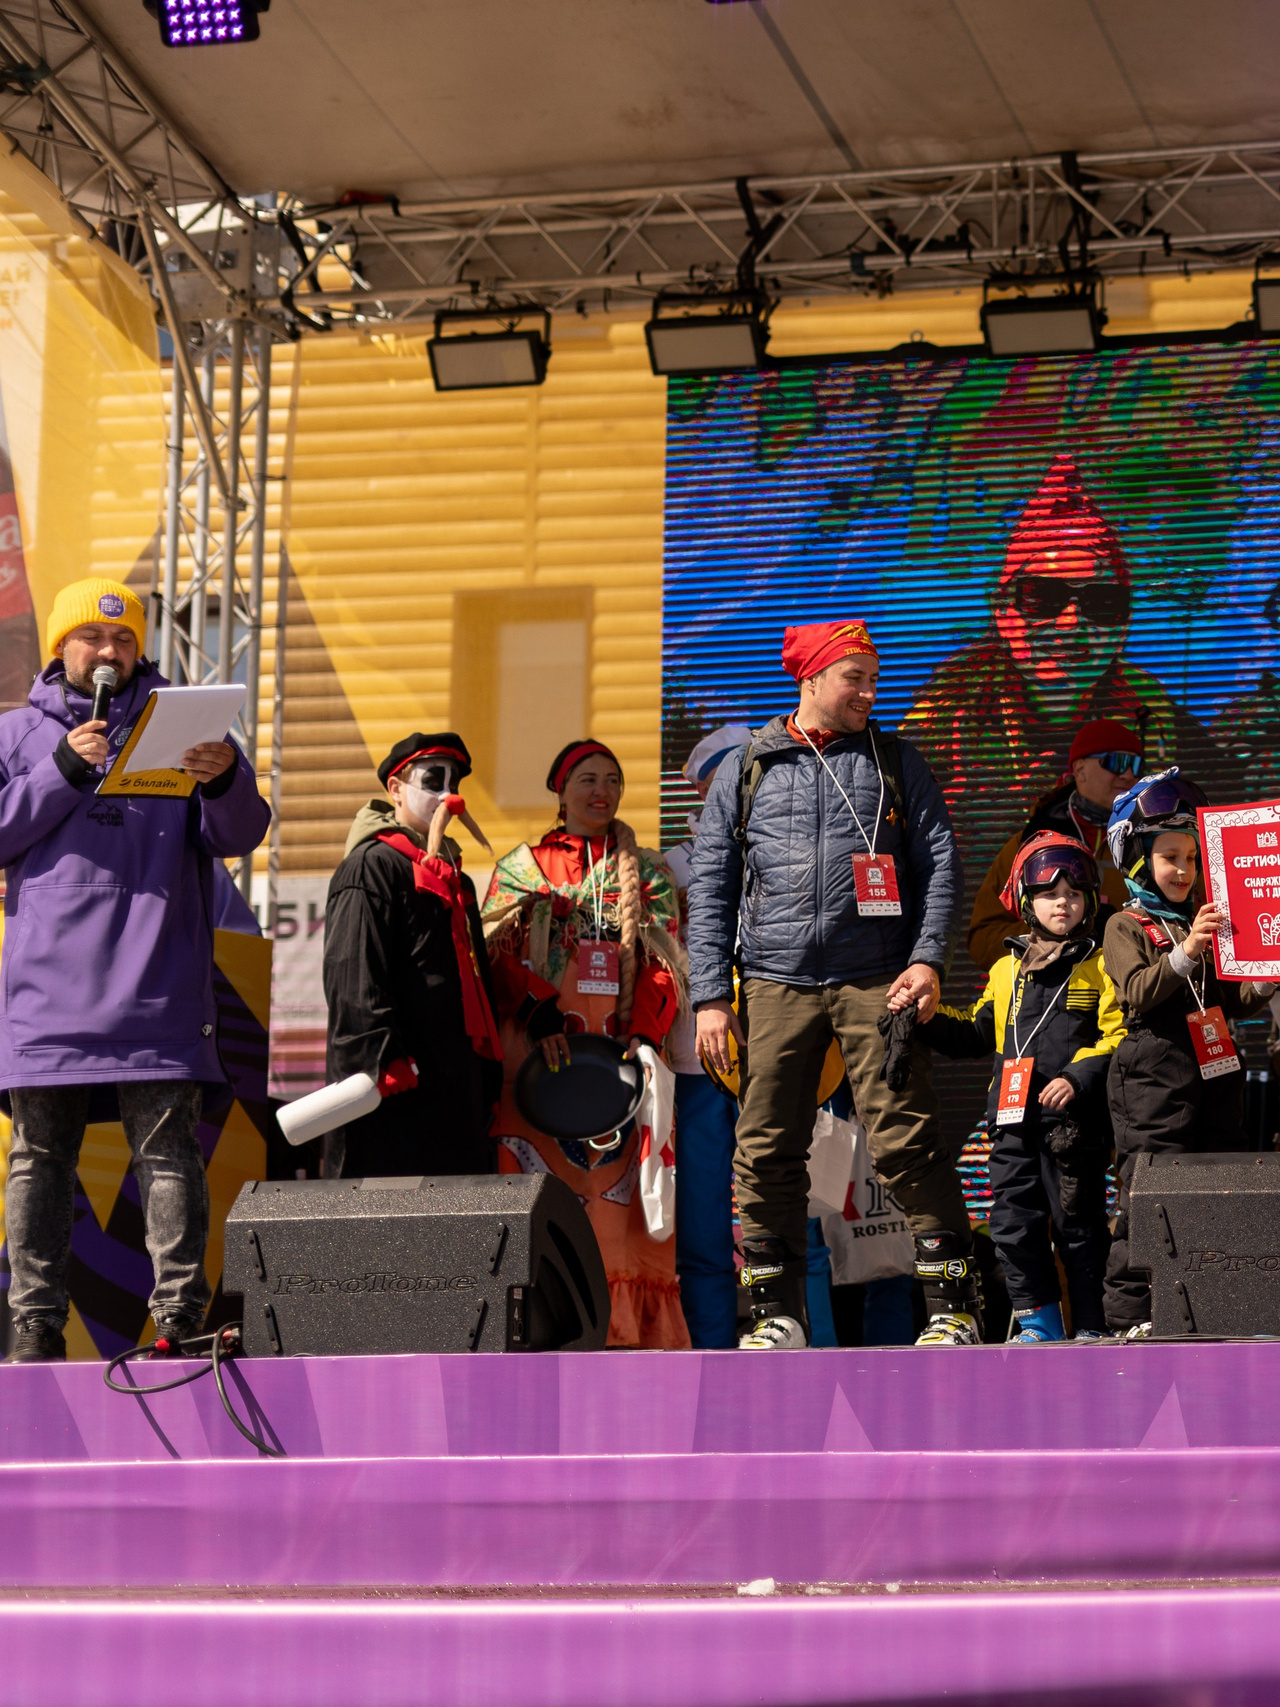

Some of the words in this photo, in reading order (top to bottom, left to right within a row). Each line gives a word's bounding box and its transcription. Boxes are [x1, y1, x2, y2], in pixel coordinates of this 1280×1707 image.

[133, 779, 178, 789] билайн
[868, 888, 887, 897] 155
[1252, 889, 1264, 898] НА
[1266, 888, 1270, 897] 1
[590, 969, 607, 977] 124
[1207, 1044, 1224, 1056] 180
[1007, 1094, 1020, 1104] 179
[852, 1220, 908, 1238] ROSTI
[274, 1273, 478, 1295] ProTone
